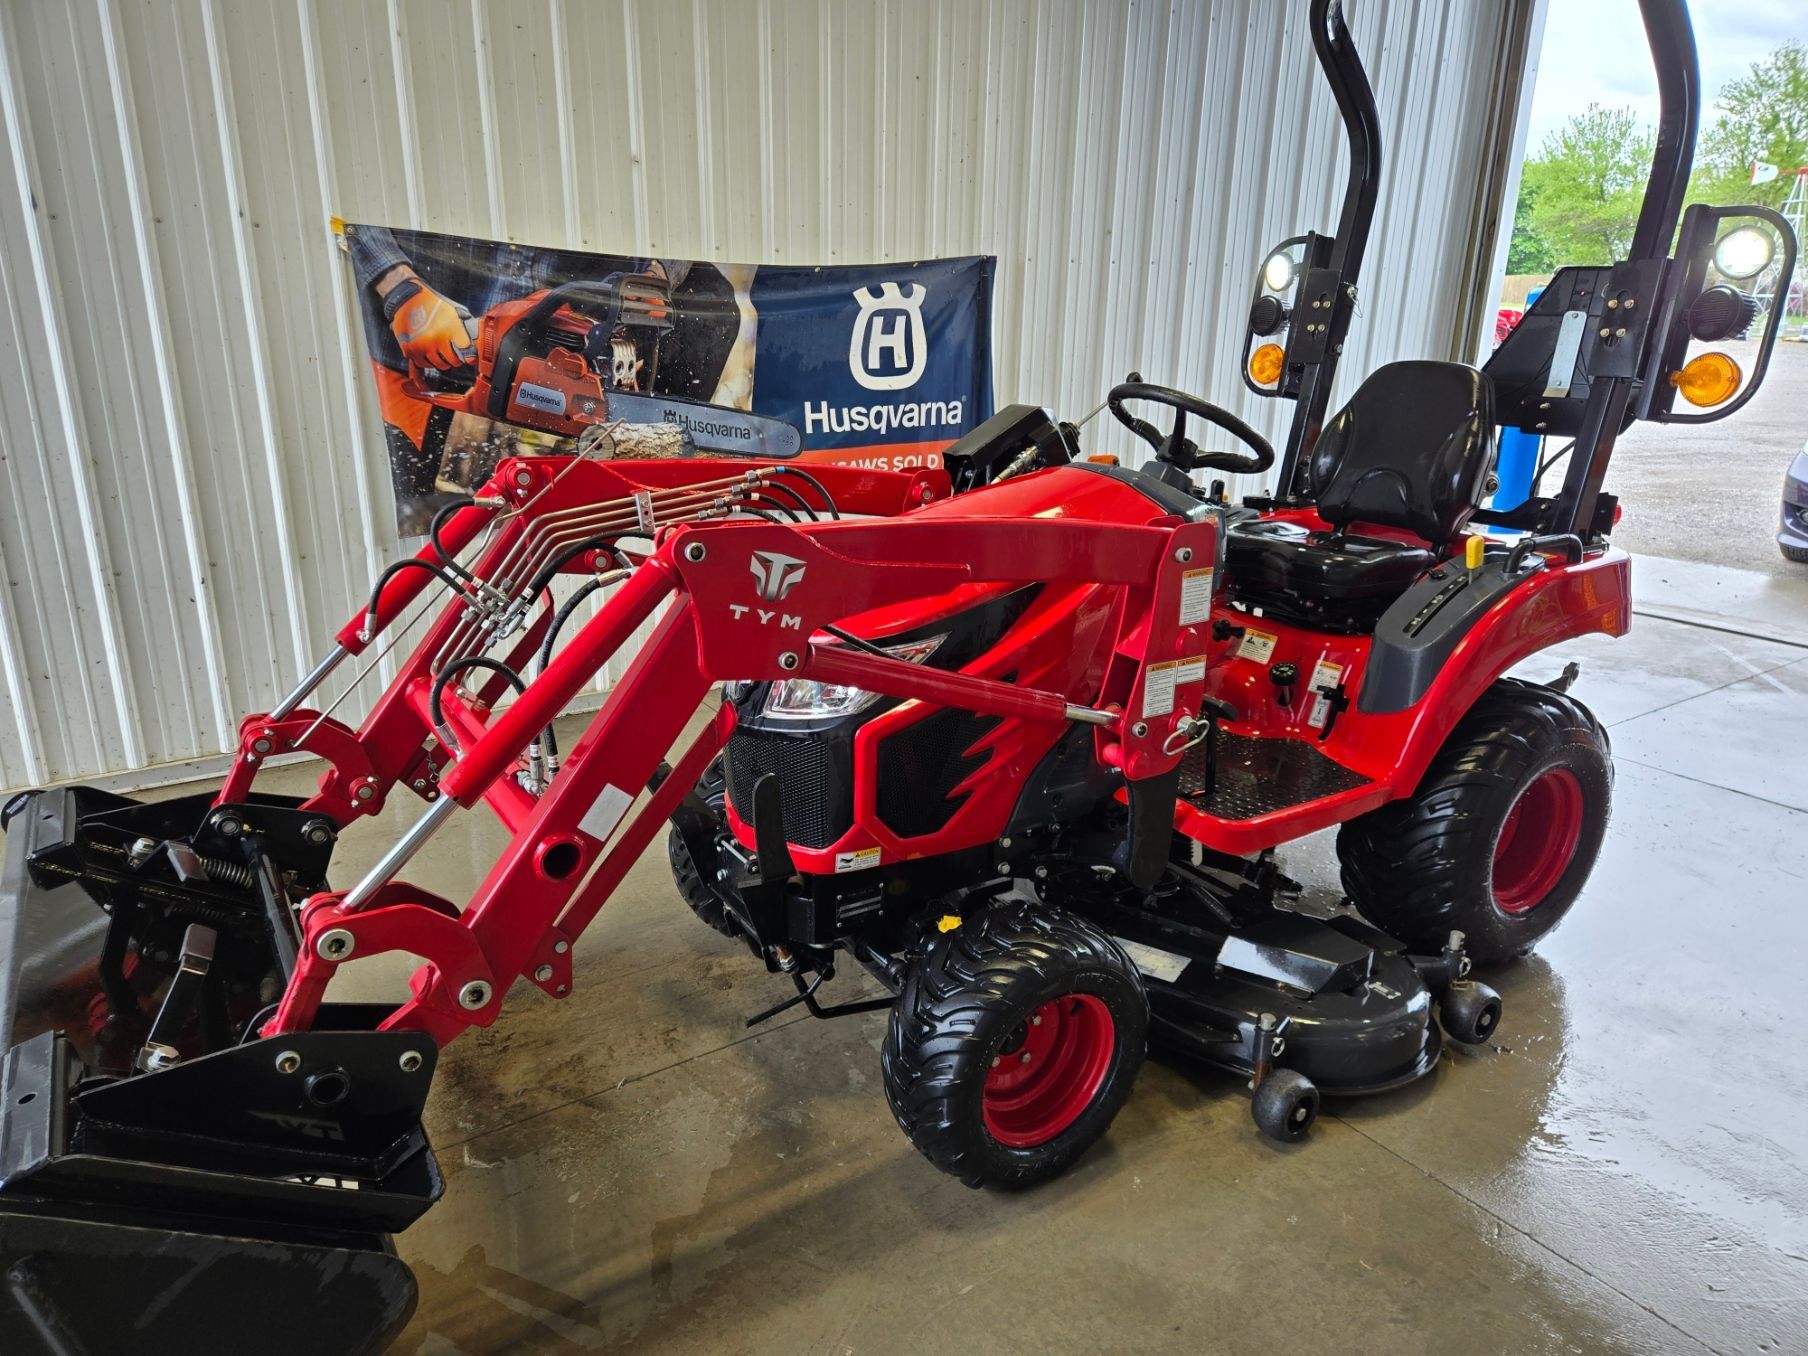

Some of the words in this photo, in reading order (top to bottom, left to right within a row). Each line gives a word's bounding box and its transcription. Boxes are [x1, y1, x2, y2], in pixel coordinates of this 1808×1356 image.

[527, 392, 561, 407] Husqvarna
[678, 415, 751, 440] Husqvarna
[804, 400, 962, 434] Husqvarna
[729, 603, 802, 630] TYM
